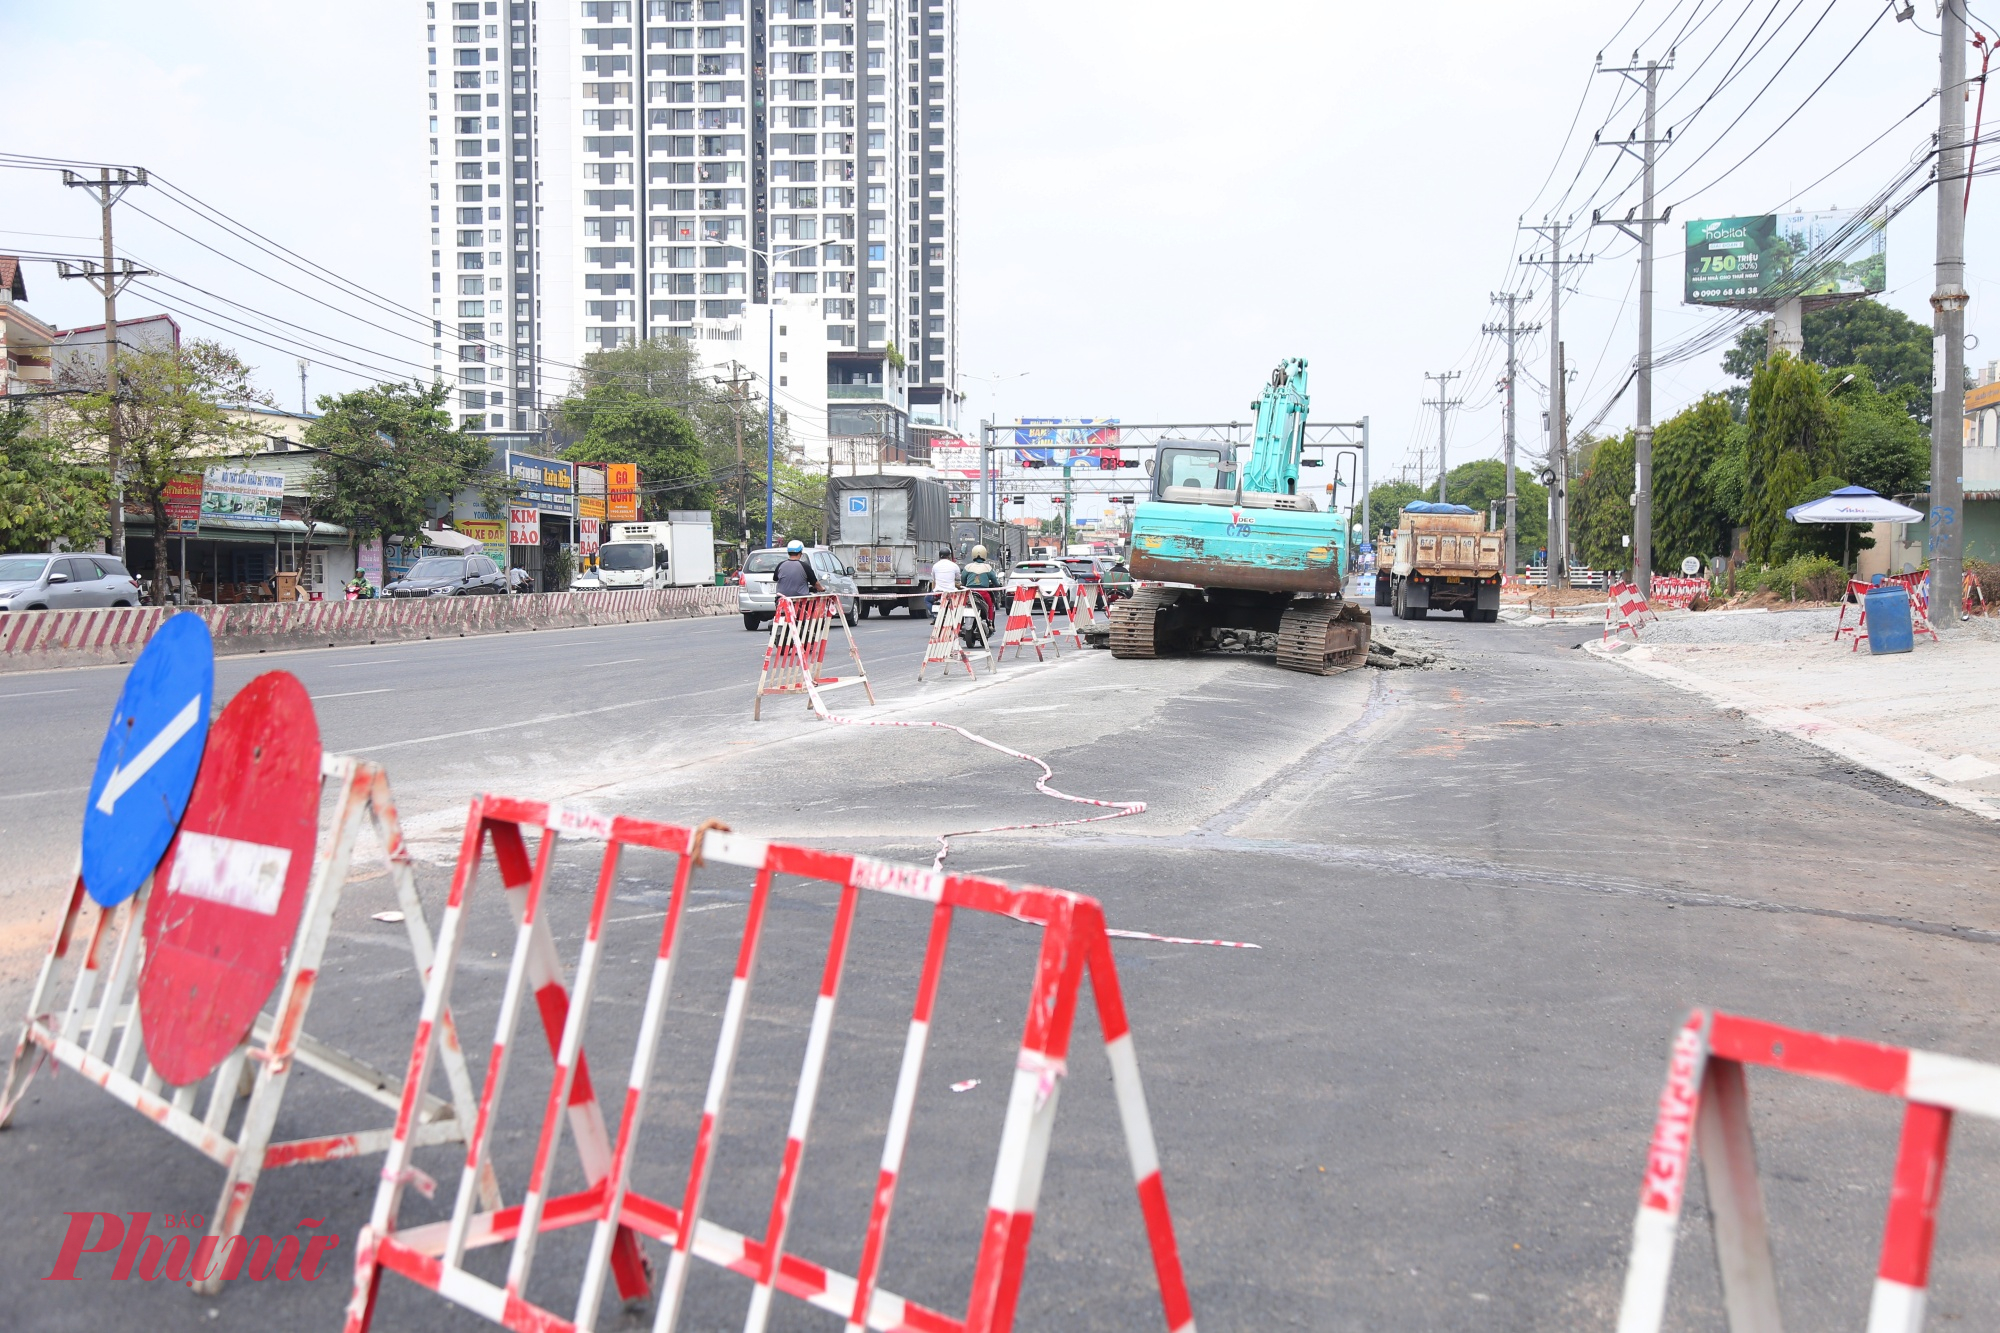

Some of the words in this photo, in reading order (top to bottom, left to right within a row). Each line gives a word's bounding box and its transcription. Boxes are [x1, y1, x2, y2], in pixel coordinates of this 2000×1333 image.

[1700, 255, 1736, 273] 750
[1737, 253, 1759, 263] TRIỆU
[1737, 262, 1758, 271] (30%)
[1701, 289, 1721, 297] 0909
[1723, 288, 1733, 296] 68
[1735, 287, 1745, 295] 68
[1748, 286, 1758, 294] 38
[1101, 459, 1116, 470] 23
[615, 467, 628, 485] GÀ
[511, 510, 537, 523] KIM
[581, 520, 597, 533] KIM
[1226, 523, 1252, 538] C79
[475, 530, 485, 540] XE
[488, 530, 505, 542] ĐẠP
[510, 525, 539, 544] BẢO
[580, 536, 598, 555] BẢO
